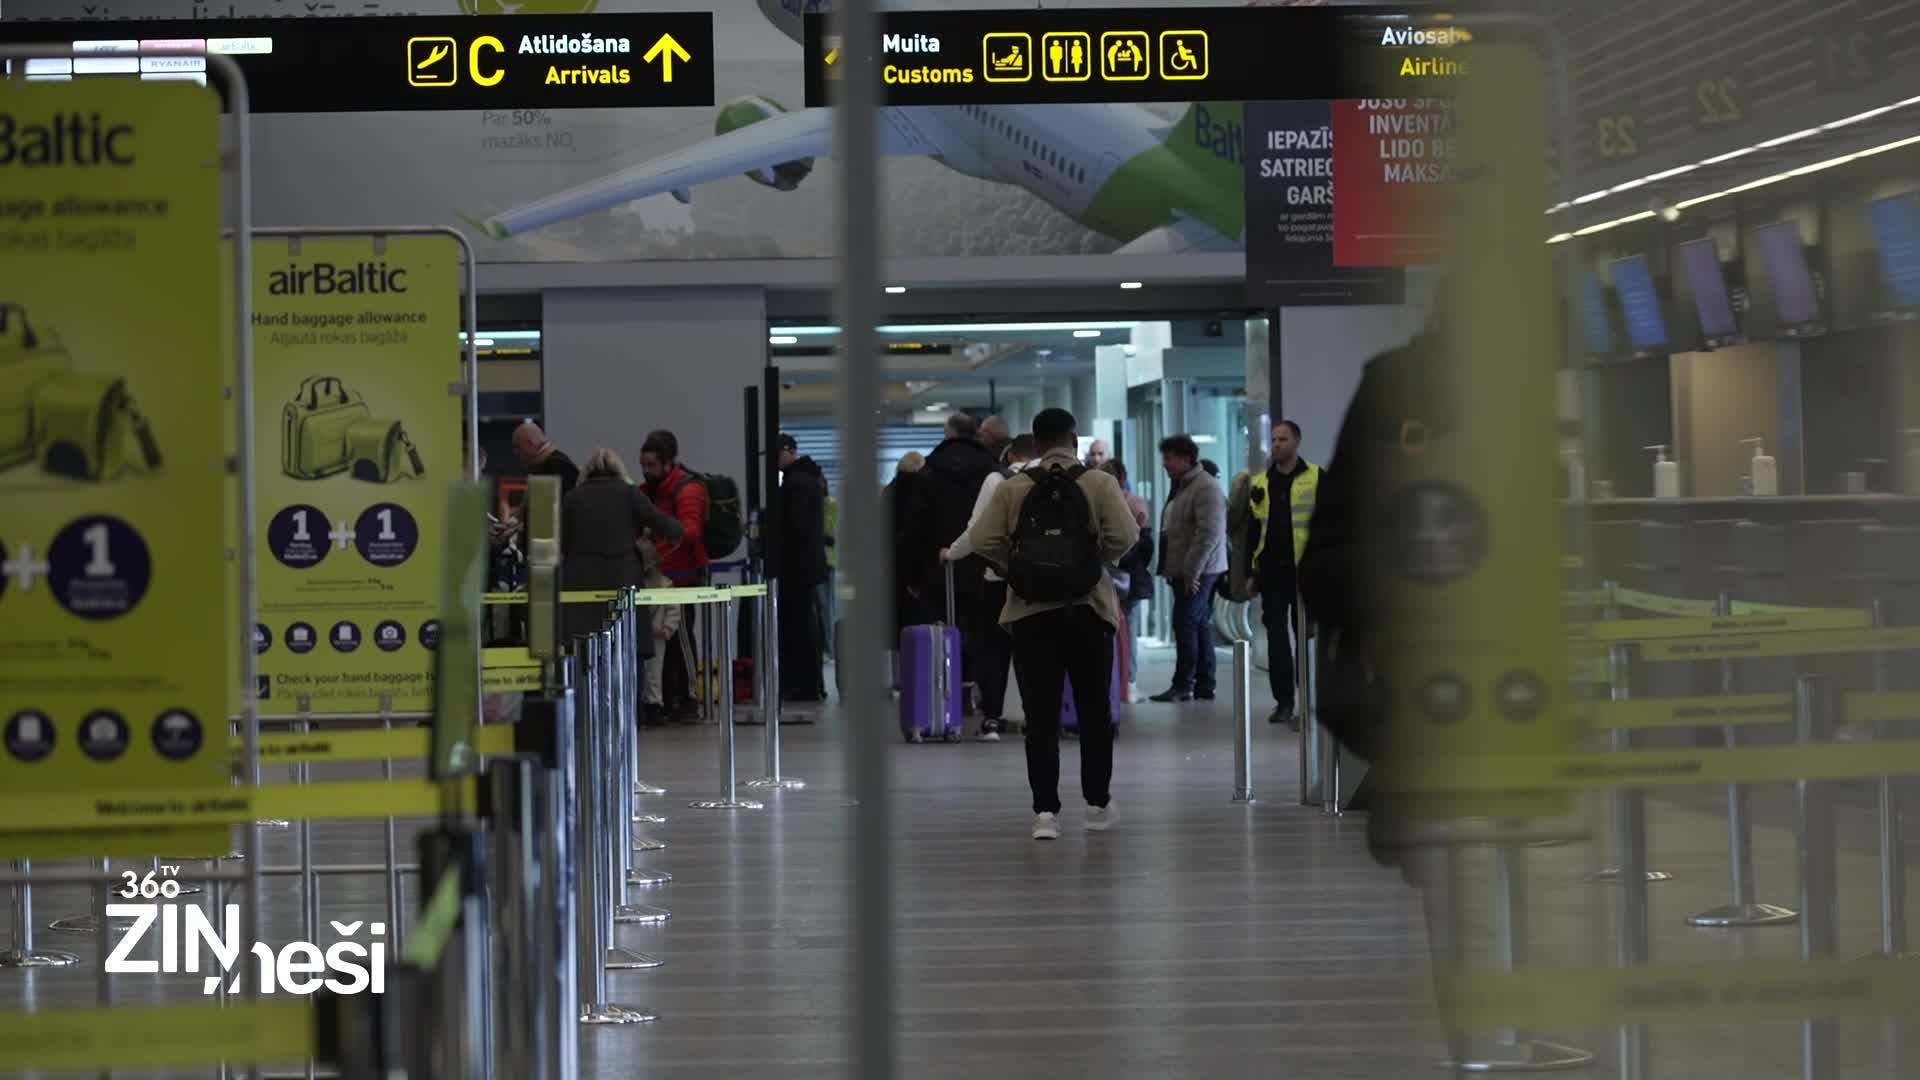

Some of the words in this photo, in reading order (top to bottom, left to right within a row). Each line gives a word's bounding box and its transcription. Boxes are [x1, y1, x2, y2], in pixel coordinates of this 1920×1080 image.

[518, 32, 630, 54] Atlidošana
[883, 33, 940, 53] Muita
[150, 59, 202, 69] RYANAIR
[468, 35, 505, 87] C
[545, 65, 630, 84] Arrivals
[883, 65, 973, 84] Customs
[511, 111, 551, 126] 50%
[1379, 139, 1424, 159] LIDO
[268, 262, 407, 295] airBaltic
[251, 313, 289, 326] Hand
[292, 312, 353, 328] baggage
[356, 311, 428, 325] allowance
[292, 510, 311, 540] 1
[377, 508, 396, 540] 1
[82, 523, 116, 576] 1
